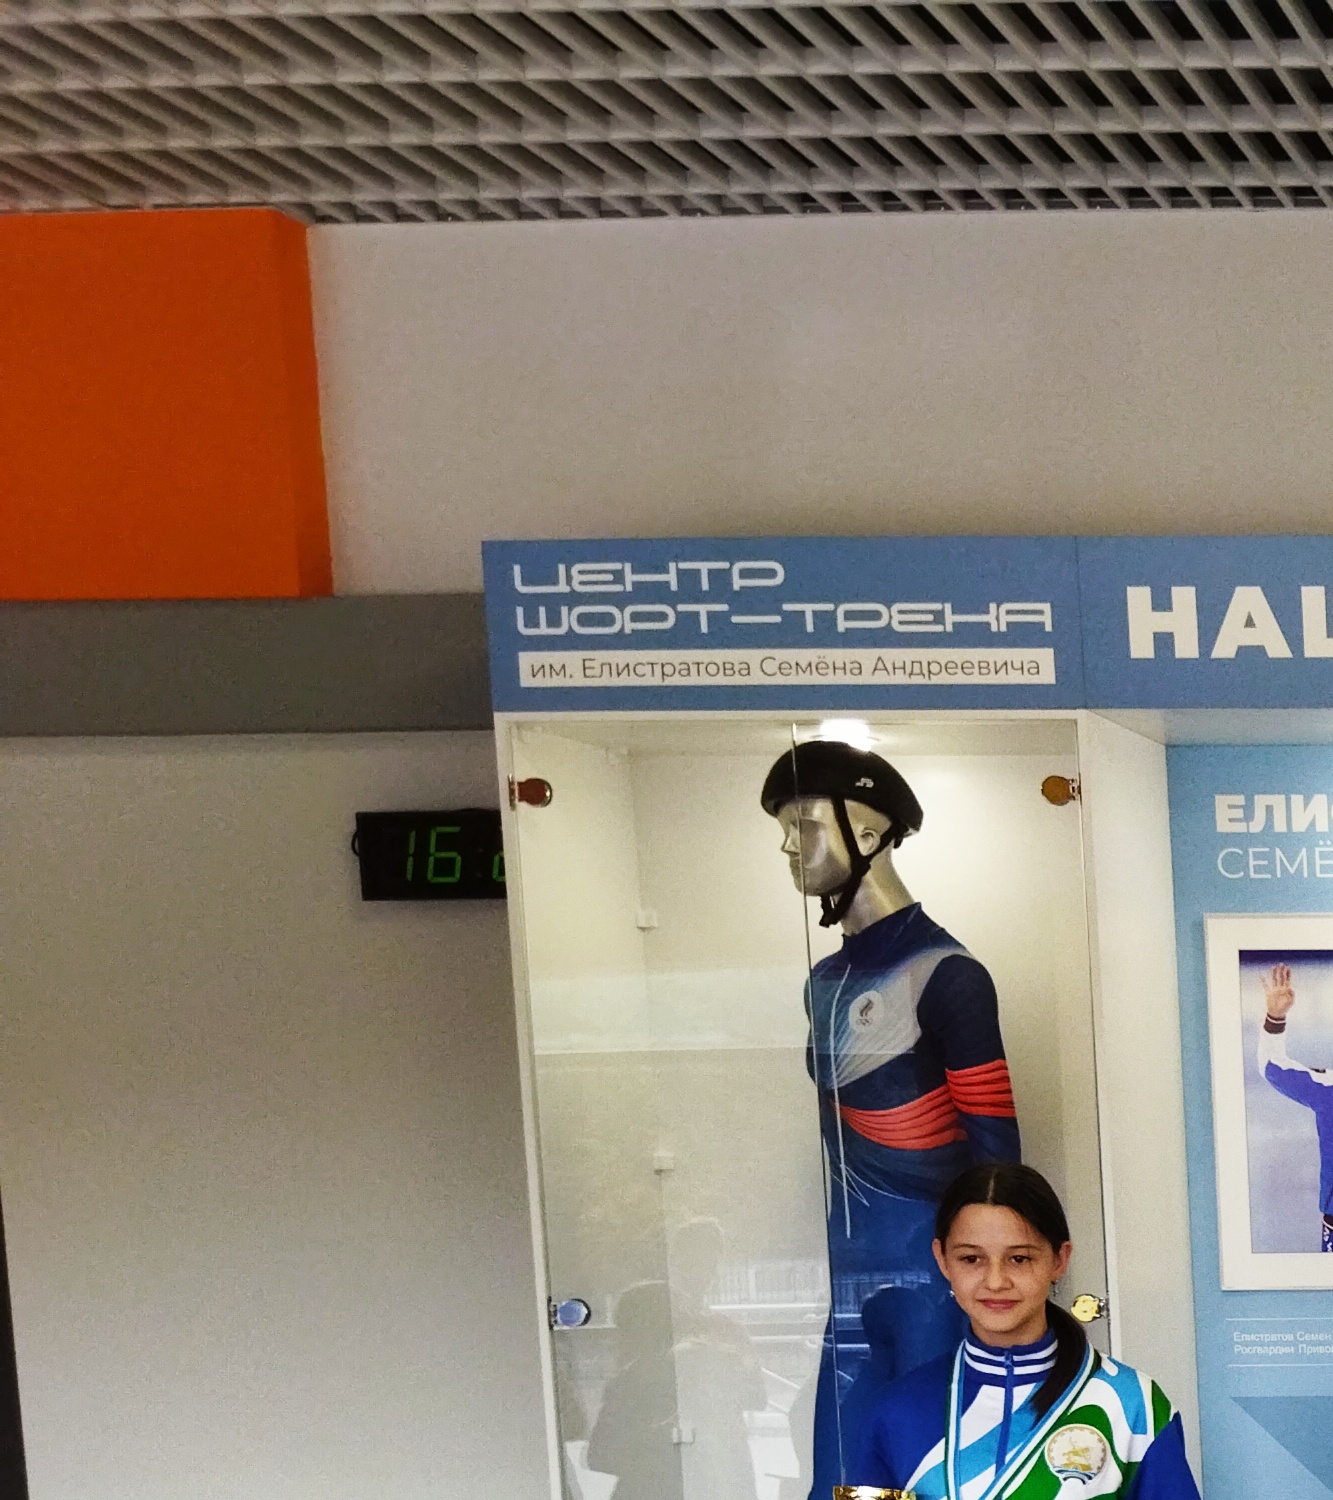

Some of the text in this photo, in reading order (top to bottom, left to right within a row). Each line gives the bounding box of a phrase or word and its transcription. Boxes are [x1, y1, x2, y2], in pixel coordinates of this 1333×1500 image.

[513, 560, 785, 594] ЦЕНТР
[514, 602, 1053, 636] ШОРТ-ТРЕКА
[531, 652, 1041, 684] им. Елистратова Семёна Андреевича
